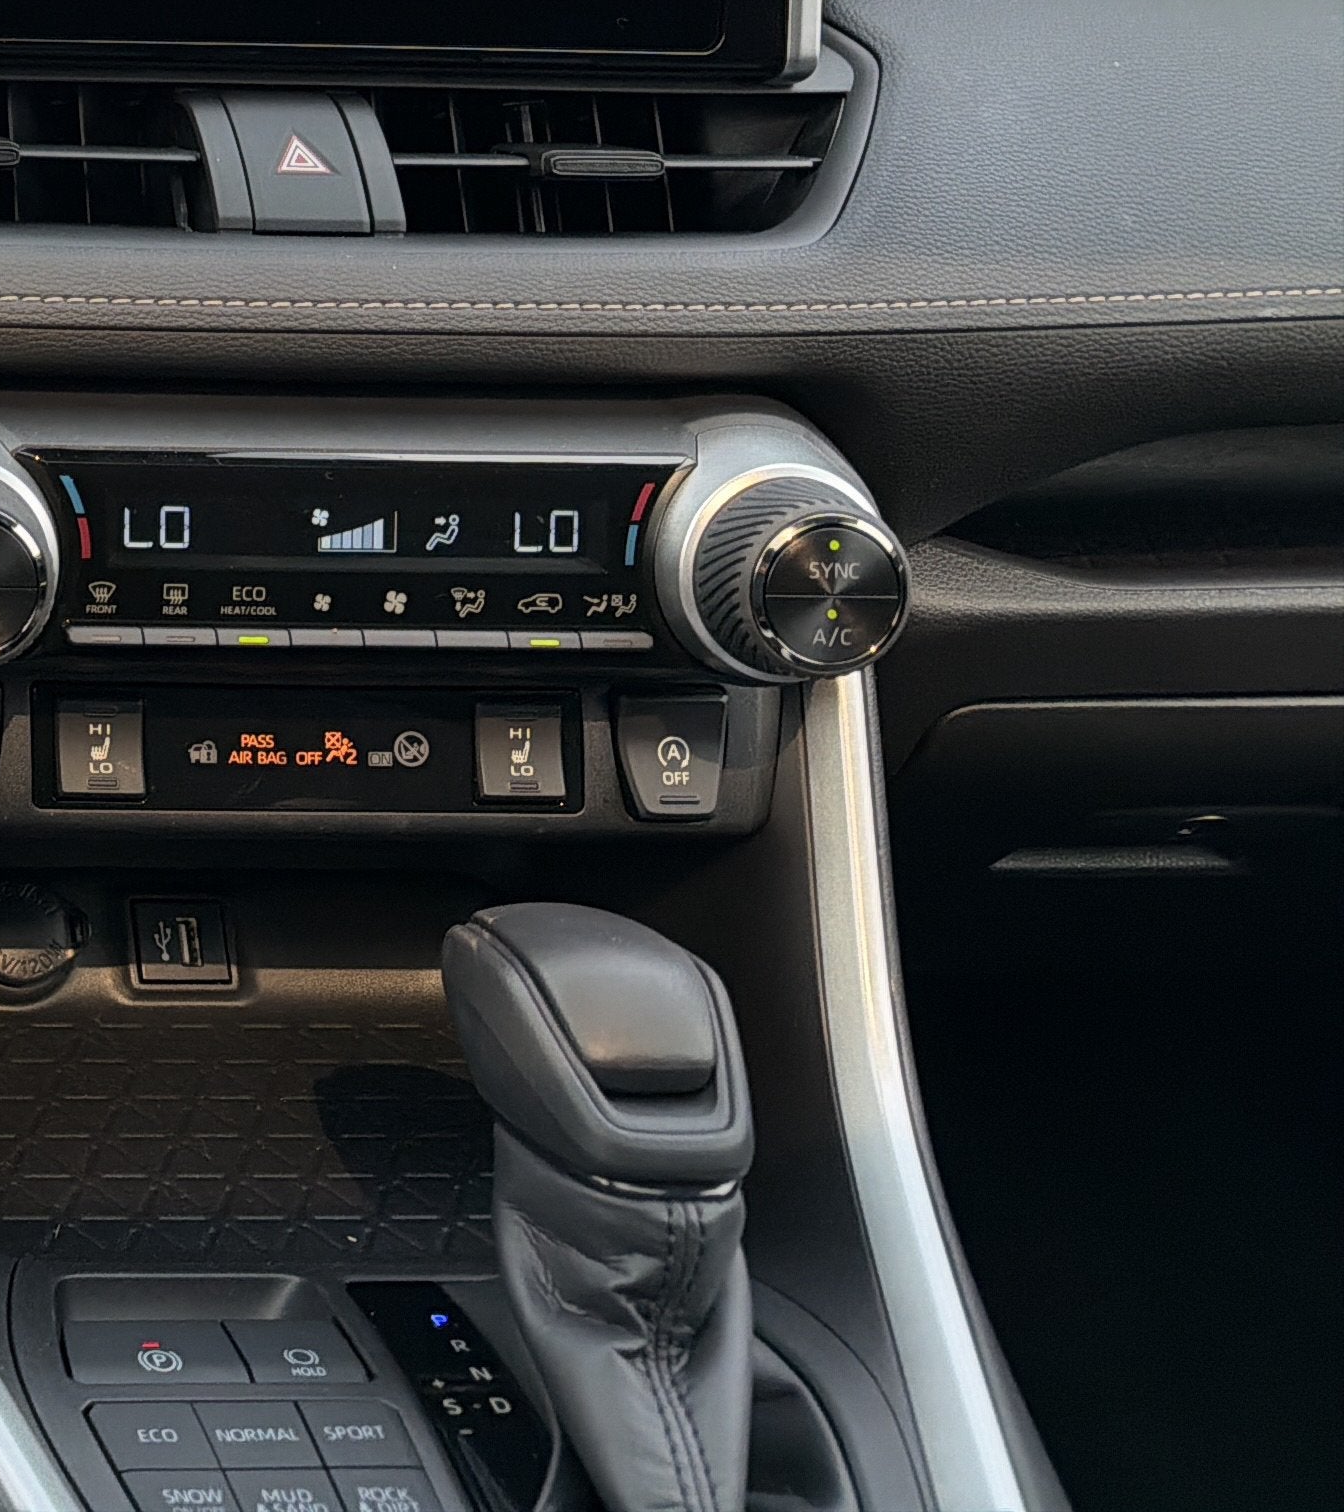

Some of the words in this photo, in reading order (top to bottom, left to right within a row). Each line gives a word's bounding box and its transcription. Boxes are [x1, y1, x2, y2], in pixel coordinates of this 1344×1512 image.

[123, 505, 190, 549] LO
[513, 509, 579, 553] LO
[808, 561, 860, 580] SYNC
[232, 586, 266, 601] ECO
[86, 604, 117, 614] FRONT
[162, 605, 188, 615] REAR
[220, 605, 277, 616] HEAT/COOL
[813, 626, 852, 648] A/C
[88, 723, 111, 736] HI
[509, 727, 531, 739] HI
[240, 734, 275, 748] PASS
[228, 750, 253, 764] AIR
[257, 750, 287, 765] BAG
[295, 751, 323, 765] OFF
[370, 752, 391, 765] ON
[89, 762, 113, 774] LO
[511, 765, 534, 777] LO
[662, 771, 690, 785] OFF
[430, 1314, 449, 1328] P
[450, 1339, 470, 1352] R
[291, 1366, 327, 1377] HOLD
[468, 1366, 493, 1381] N
[442, 1398, 463, 1416] S
[489, 1397, 512, 1415] D
[136, 1428, 178, 1444] ECO
[215, 1427, 300, 1443] NORMAL
[323, 1425, 385, 1441] SPORT
[162, 1488, 223, 1505] SNOW
[261, 1488, 313, 1503] MUD
[357, 1486, 408, 1502] ROCK
